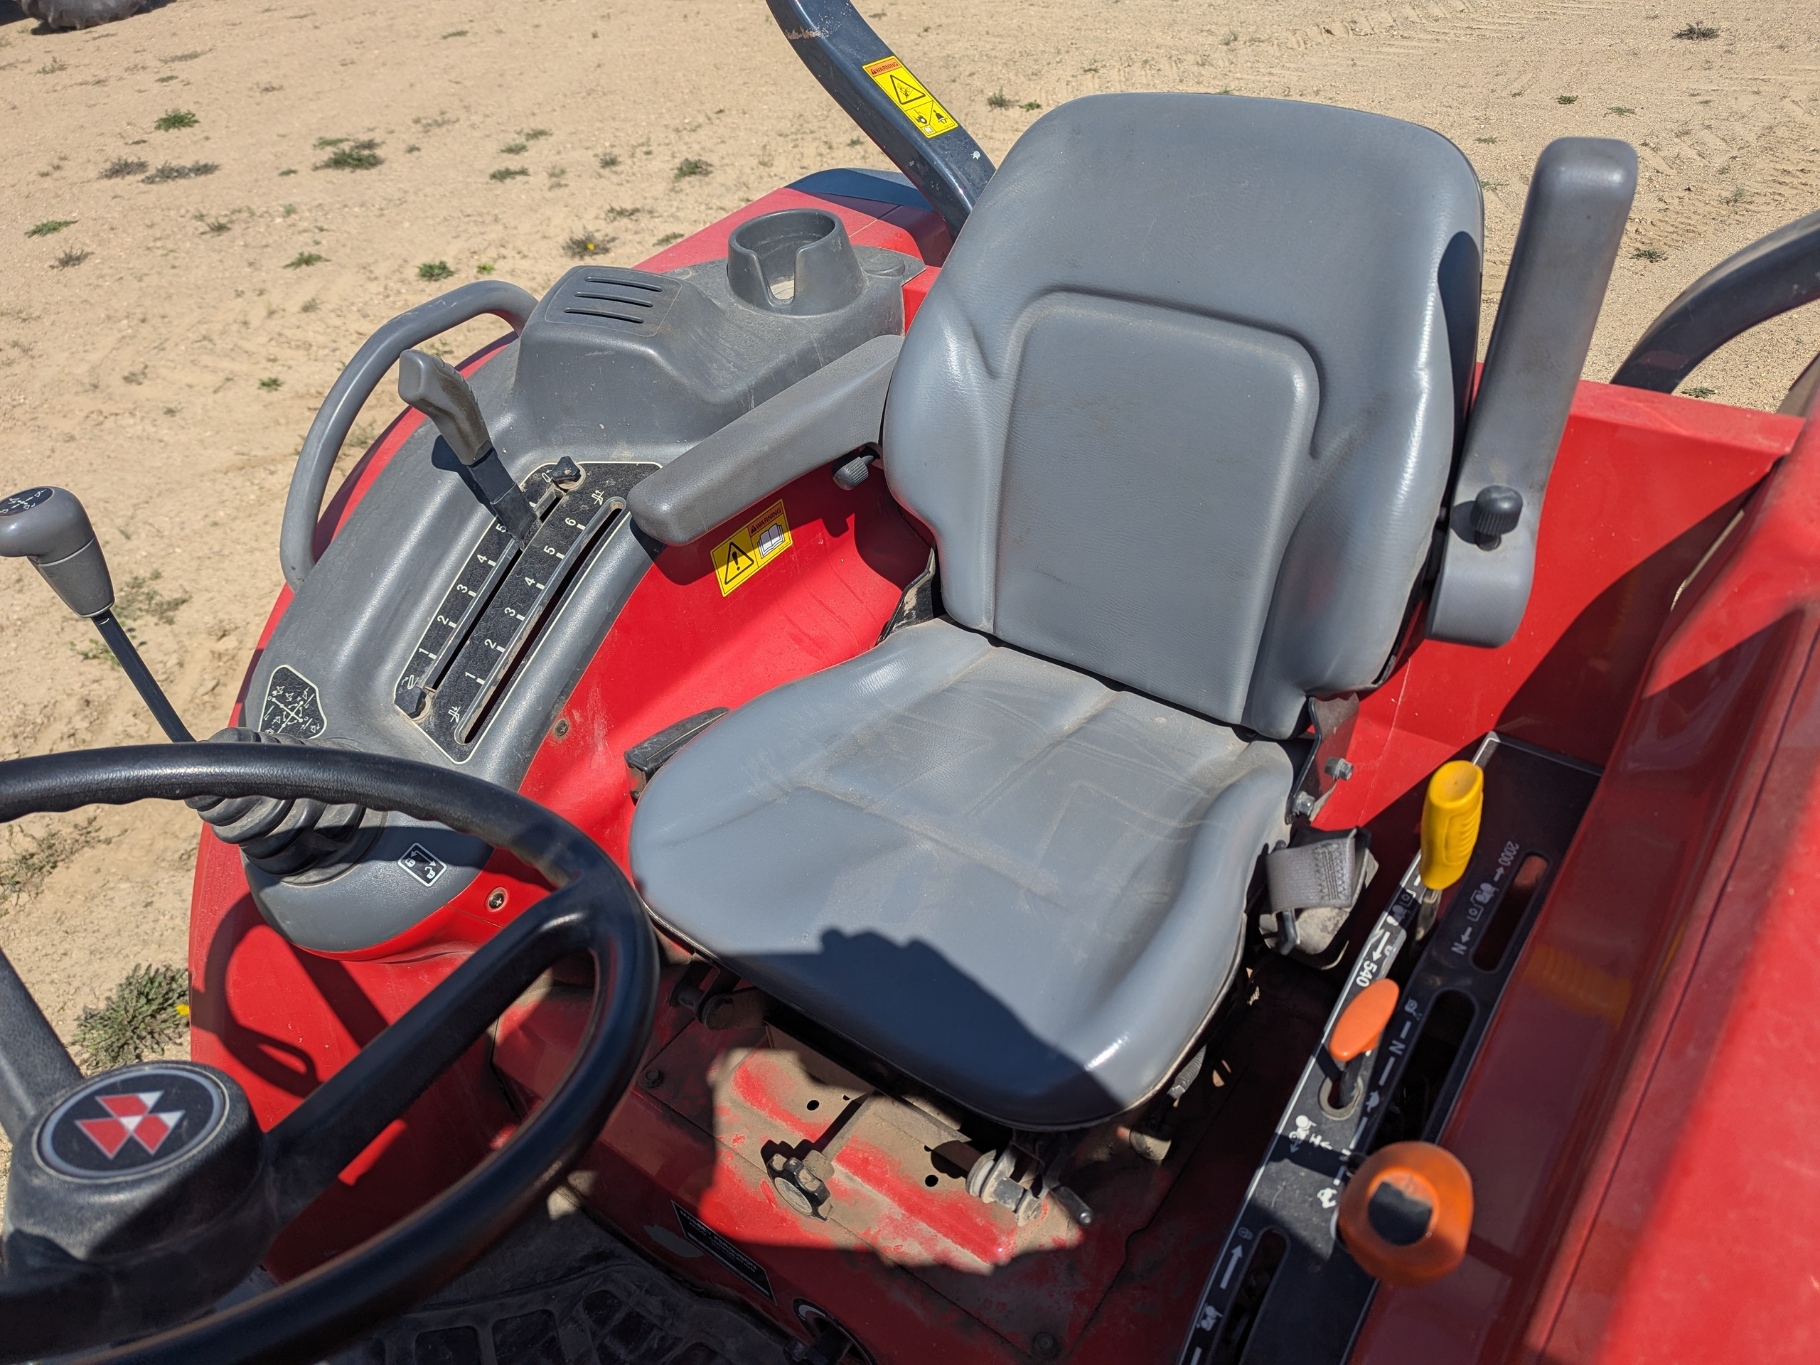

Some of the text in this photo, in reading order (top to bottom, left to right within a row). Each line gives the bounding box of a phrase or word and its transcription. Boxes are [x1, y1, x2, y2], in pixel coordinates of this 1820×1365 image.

[565, 517, 576, 526] 6
[756, 508, 781, 528] WARNING
[543, 545, 556, 555] 5
[476, 554, 487, 563] 4
[525, 577, 535, 586] 4
[457, 584, 468, 593] 3
[504, 607, 516, 617] 3
[437, 615, 449, 625] 2
[484, 639, 497, 649] 2
[418, 647, 430, 655] 1
[465, 671, 476, 679] 1
[1498, 840, 1519, 866] 2000
[1451, 942, 1468, 955] N
[1355, 960, 1378, 987] 540
[1389, 1039, 1407, 1055] N
